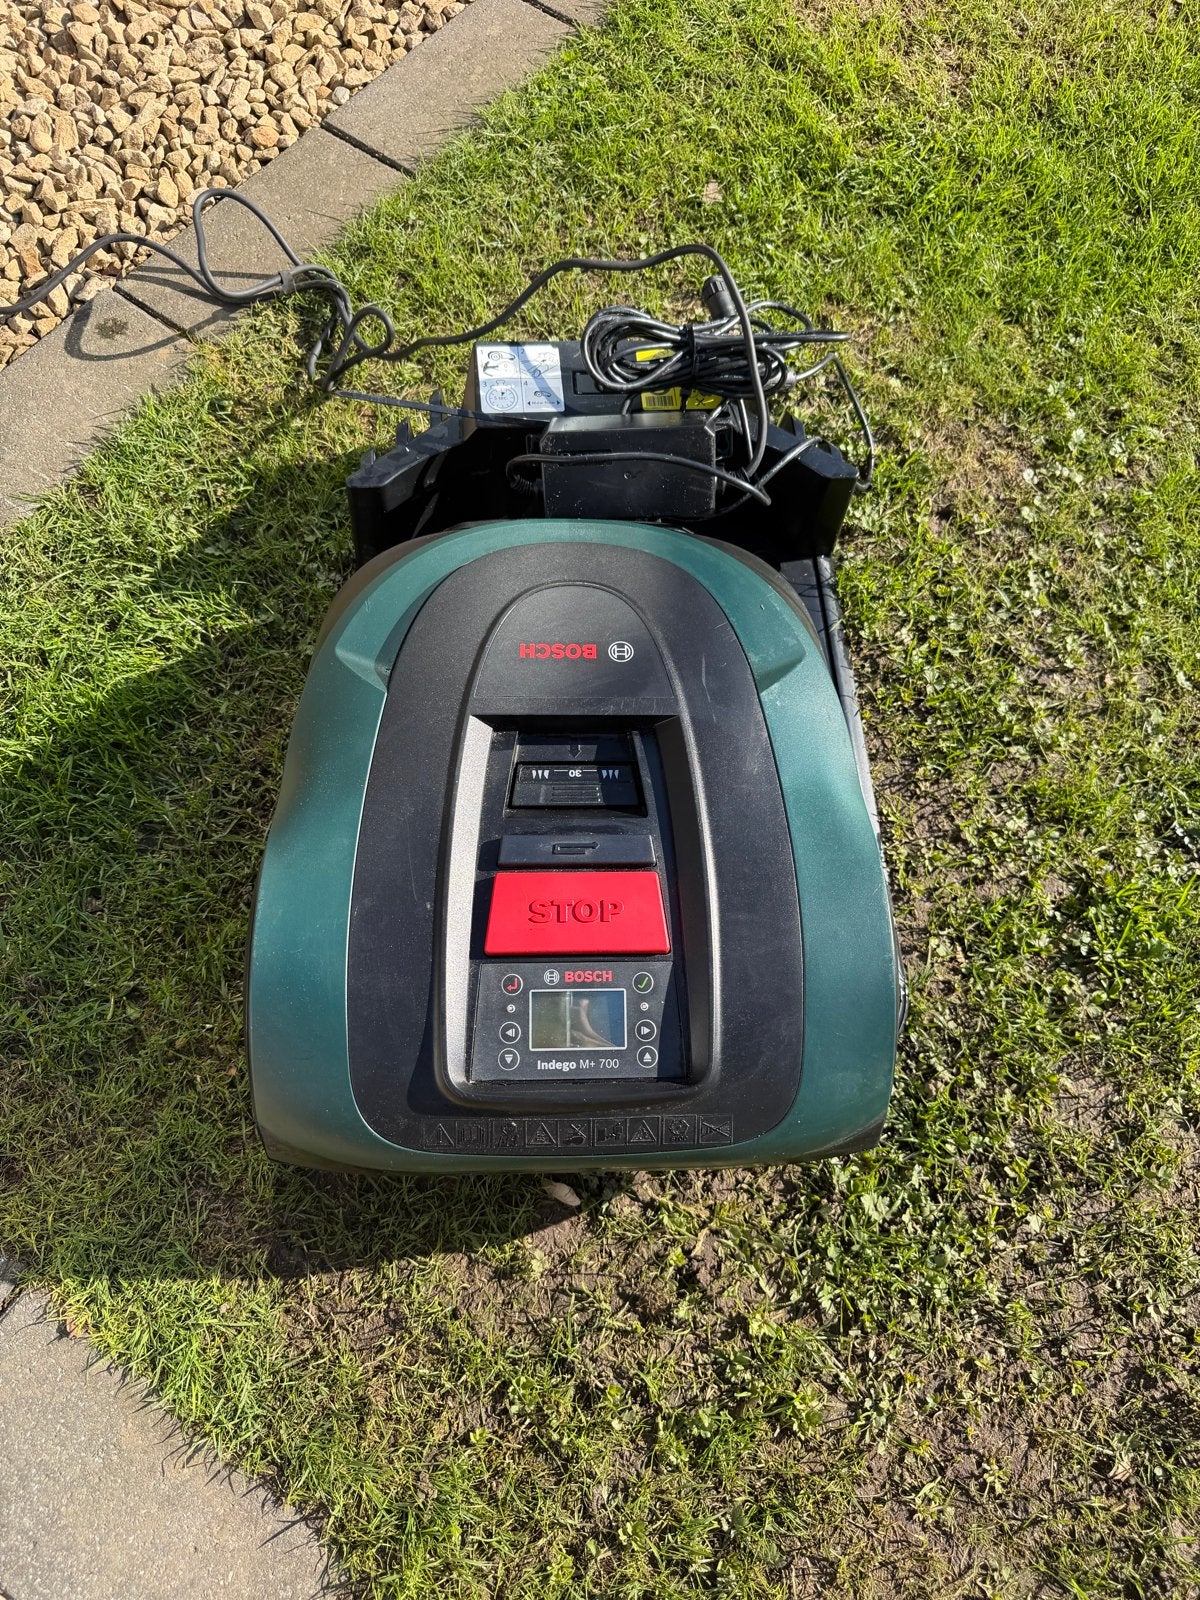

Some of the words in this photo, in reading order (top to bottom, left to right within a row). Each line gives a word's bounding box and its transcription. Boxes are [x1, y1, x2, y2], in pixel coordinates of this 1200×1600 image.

[519, 643, 597, 659] BOSCH
[568, 769, 582, 778] 30
[528, 899, 625, 924] STOP
[564, 970, 614, 983] BOSCH
[537, 1059, 577, 1072] Indego
[579, 1059, 596, 1069] M+
[599, 1058, 620, 1069] 700
